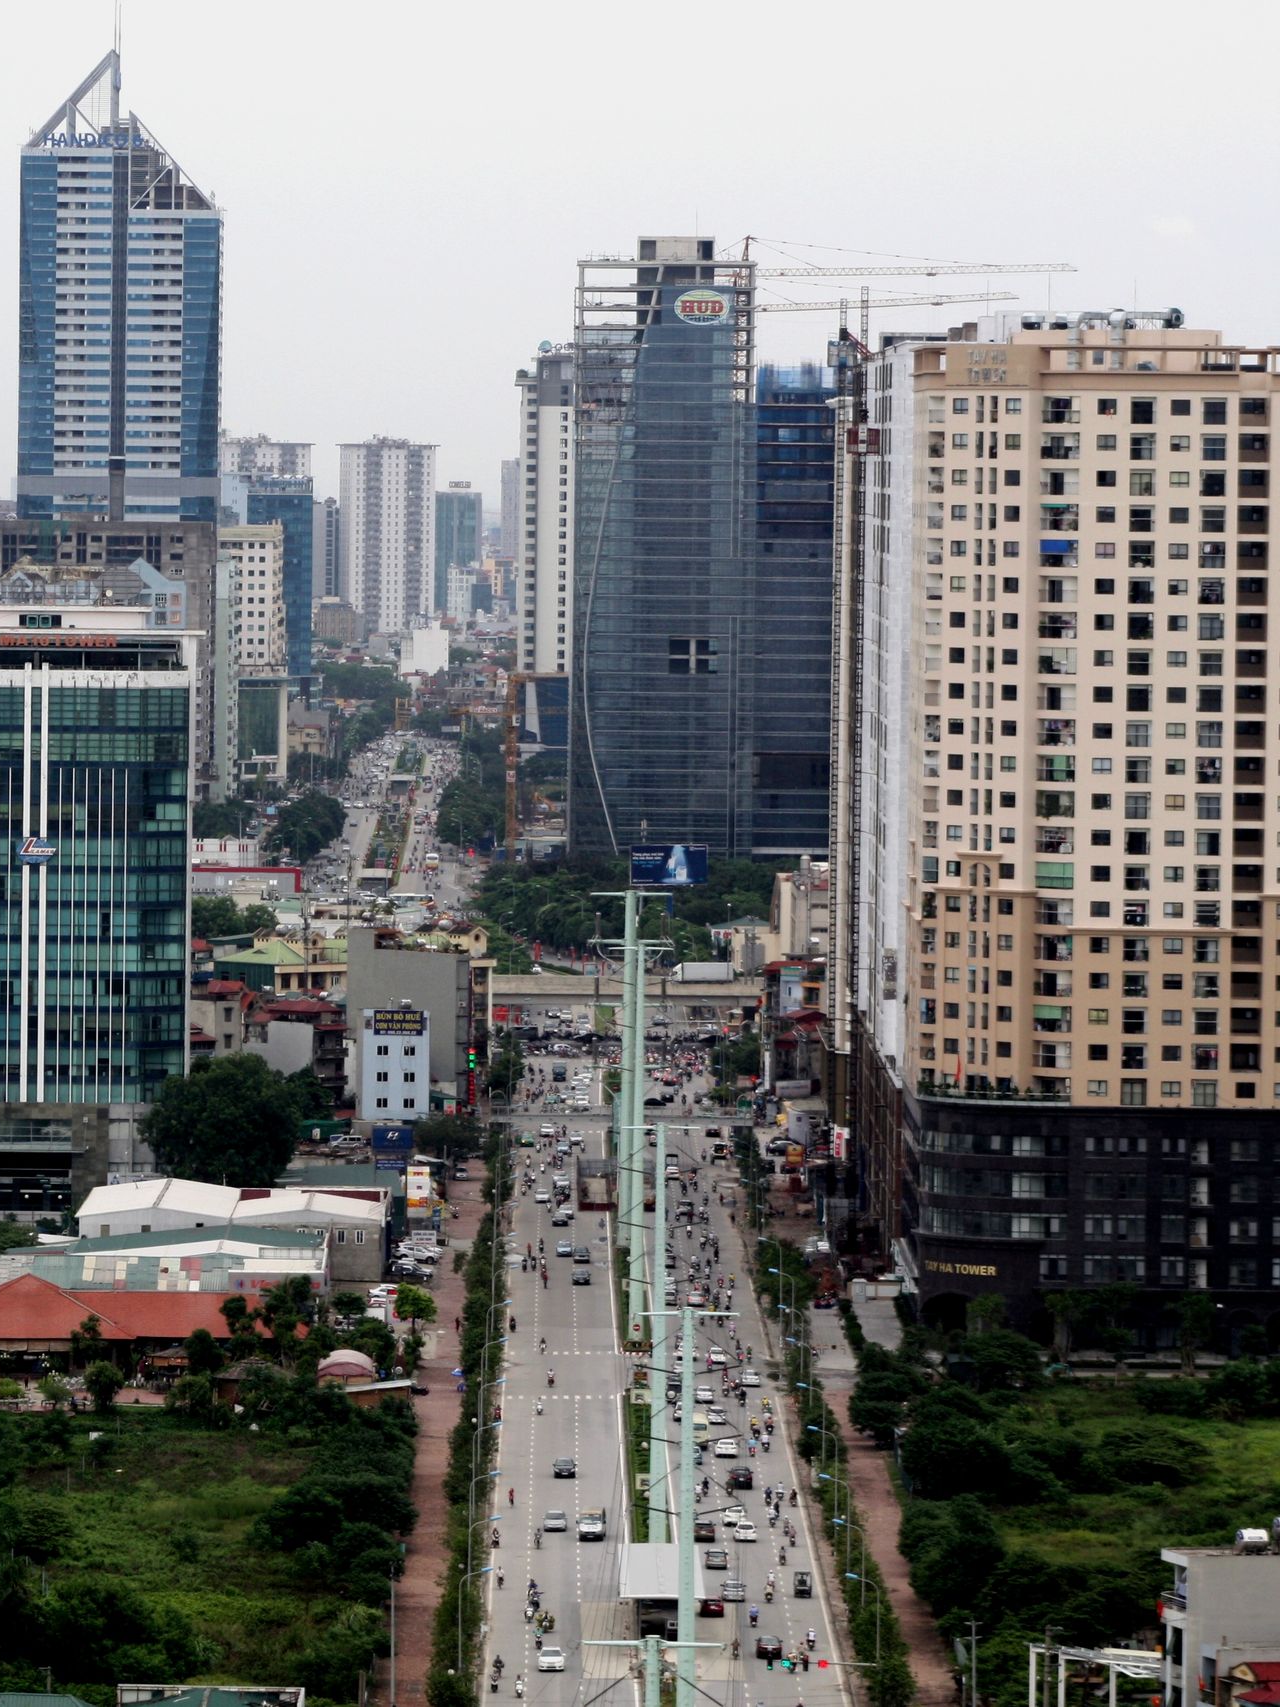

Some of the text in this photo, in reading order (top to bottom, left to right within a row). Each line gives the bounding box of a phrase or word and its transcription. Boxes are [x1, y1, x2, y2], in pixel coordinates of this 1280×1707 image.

[680, 300, 724, 313] HUD
[53, 634, 117, 648] TOWER
[939, 1262, 953, 1273] HA
[954, 1263, 998, 1276] TOWER
